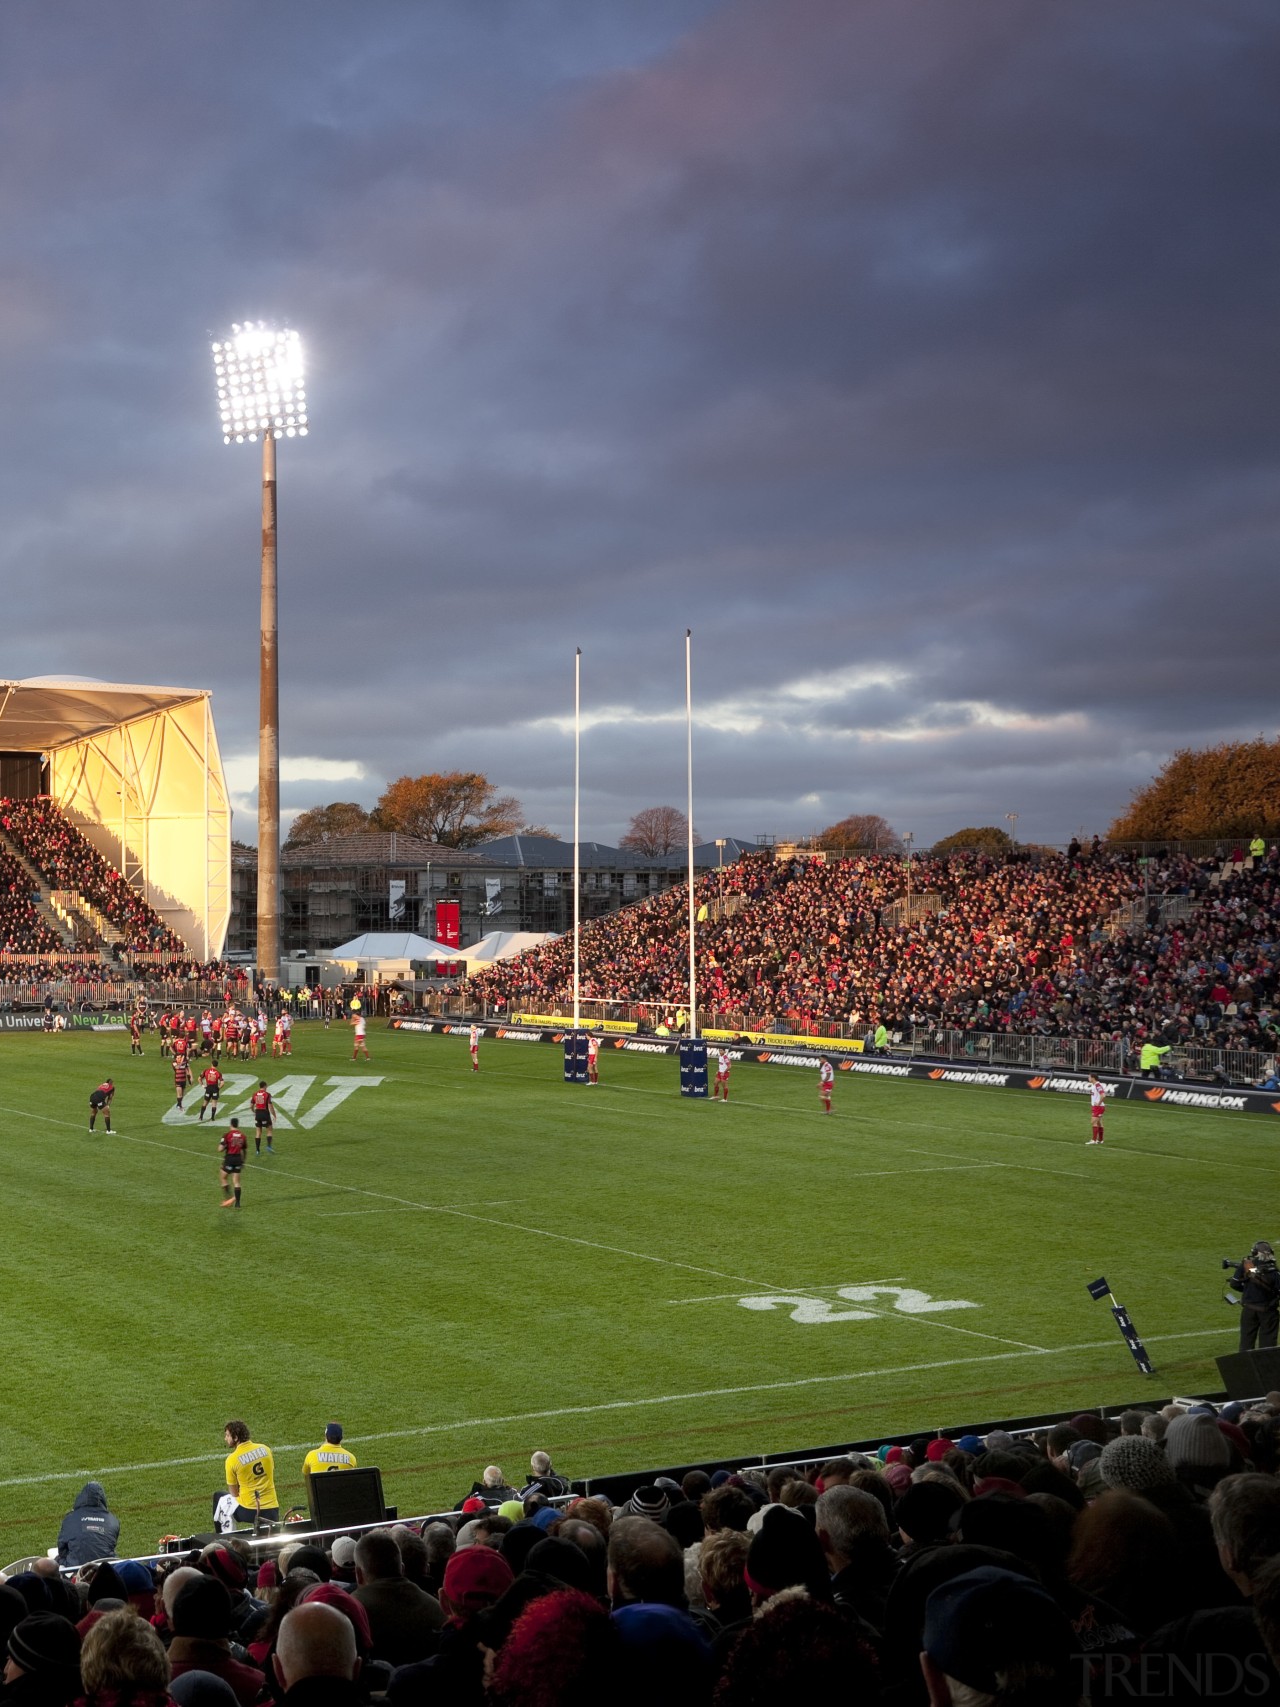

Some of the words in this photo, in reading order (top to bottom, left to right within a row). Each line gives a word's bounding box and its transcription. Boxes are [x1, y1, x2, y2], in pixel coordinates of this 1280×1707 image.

[72, 1014, 100, 1026] New
[162, 1073, 386, 1130] CAT
[737, 1285, 985, 1324] 22
[238, 1447, 268, 1466] WATER
[317, 1452, 350, 1464] WATER
[252, 1462, 265, 1476] G
